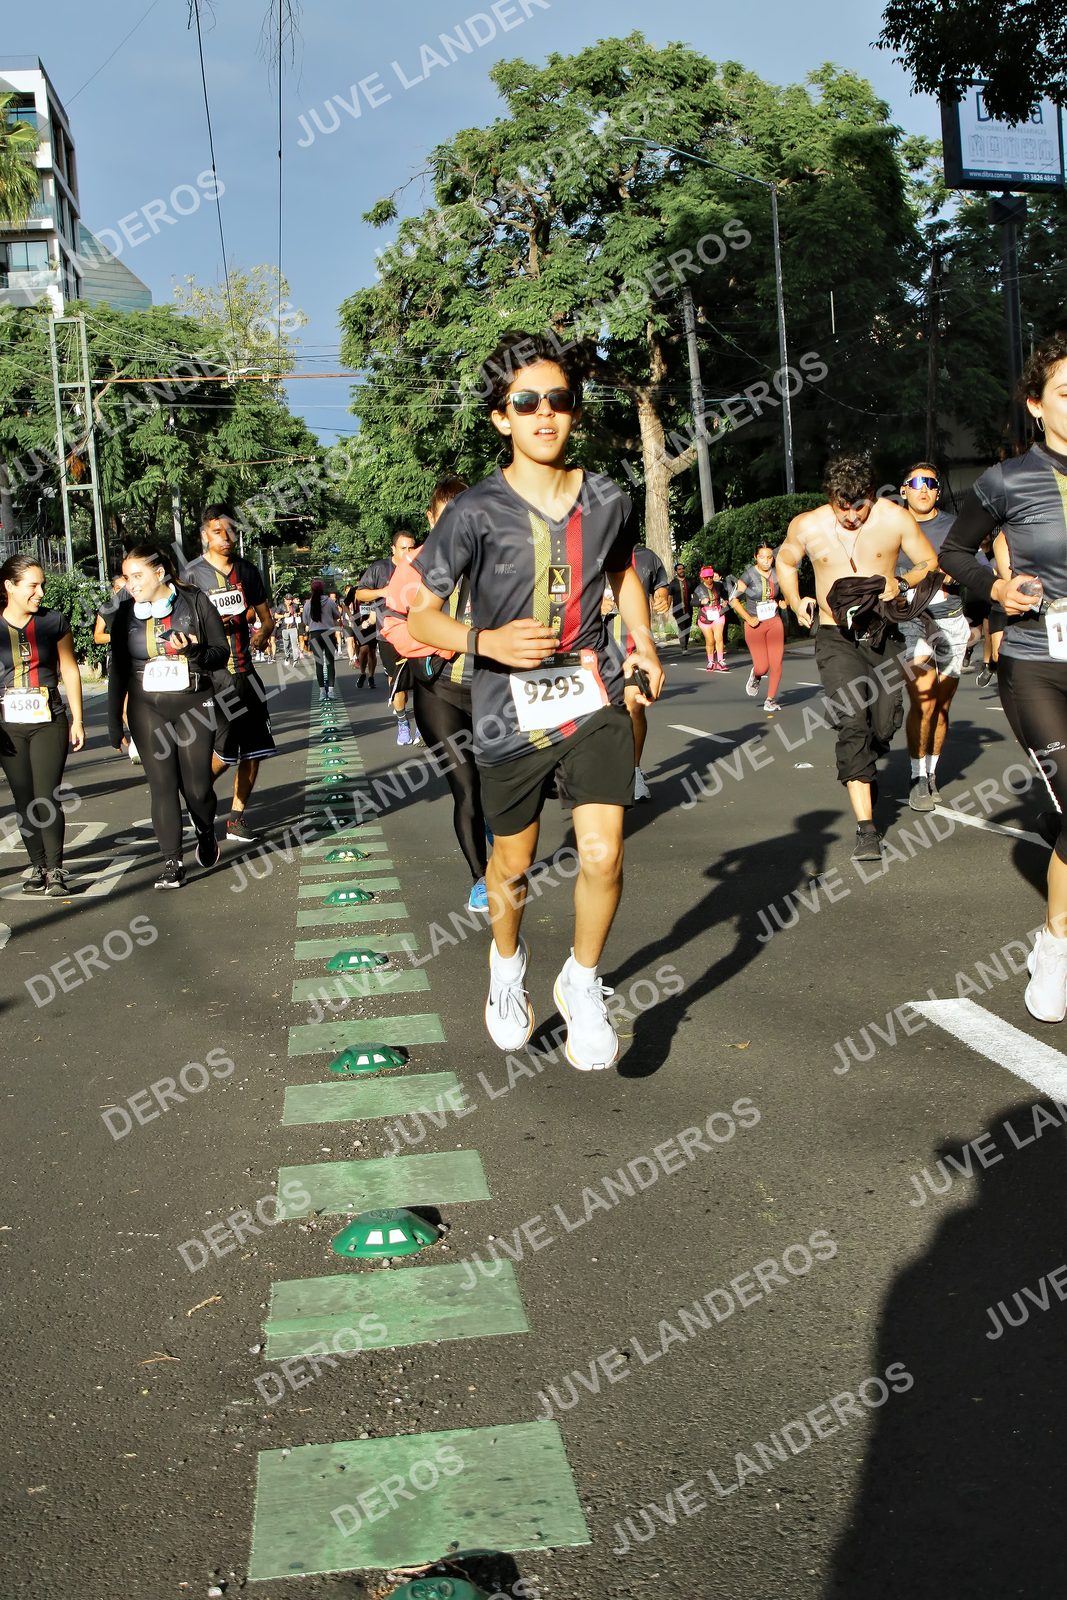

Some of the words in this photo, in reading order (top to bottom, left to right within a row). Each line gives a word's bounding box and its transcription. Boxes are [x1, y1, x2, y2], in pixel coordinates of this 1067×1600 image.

[213, 594, 242, 608] 10880
[148, 665, 178, 679] 4574
[524, 674, 585, 705] 9295
[10, 698, 40, 711] 4580
